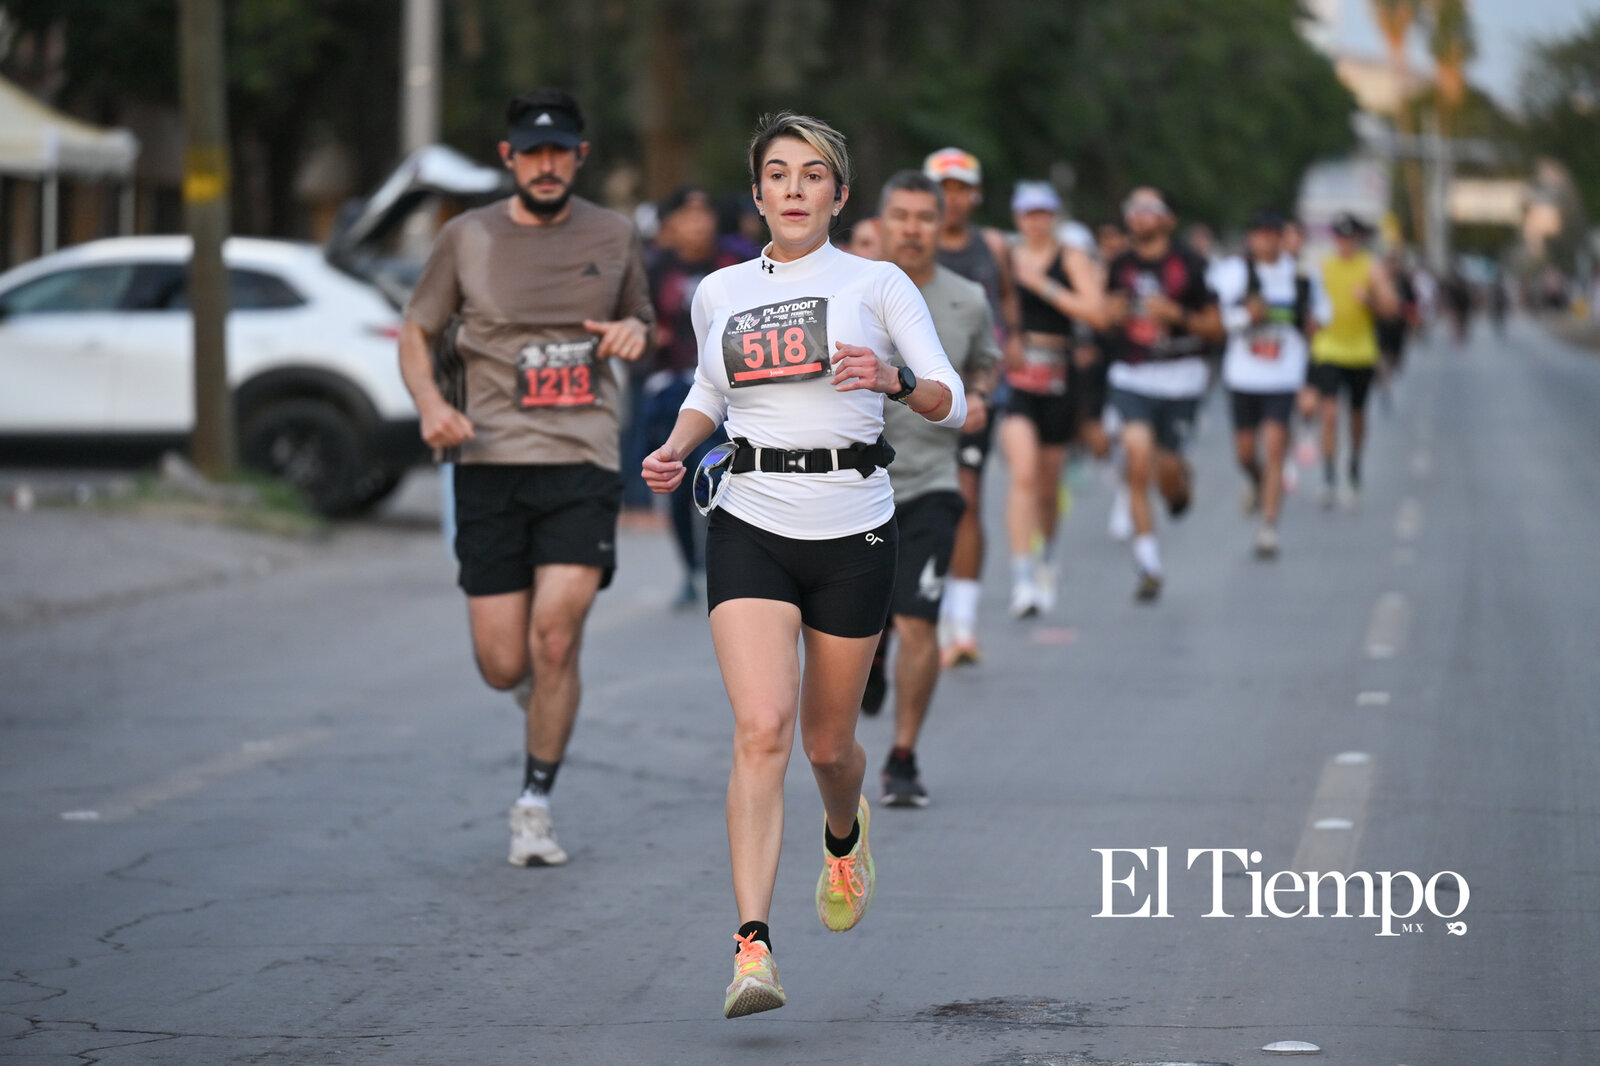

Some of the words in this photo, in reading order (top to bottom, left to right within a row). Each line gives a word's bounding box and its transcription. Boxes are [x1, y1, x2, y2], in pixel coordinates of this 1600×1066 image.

[763, 300, 819, 316] PLAYDOIT
[742, 326, 807, 369] 518
[526, 364, 591, 396] 1213
